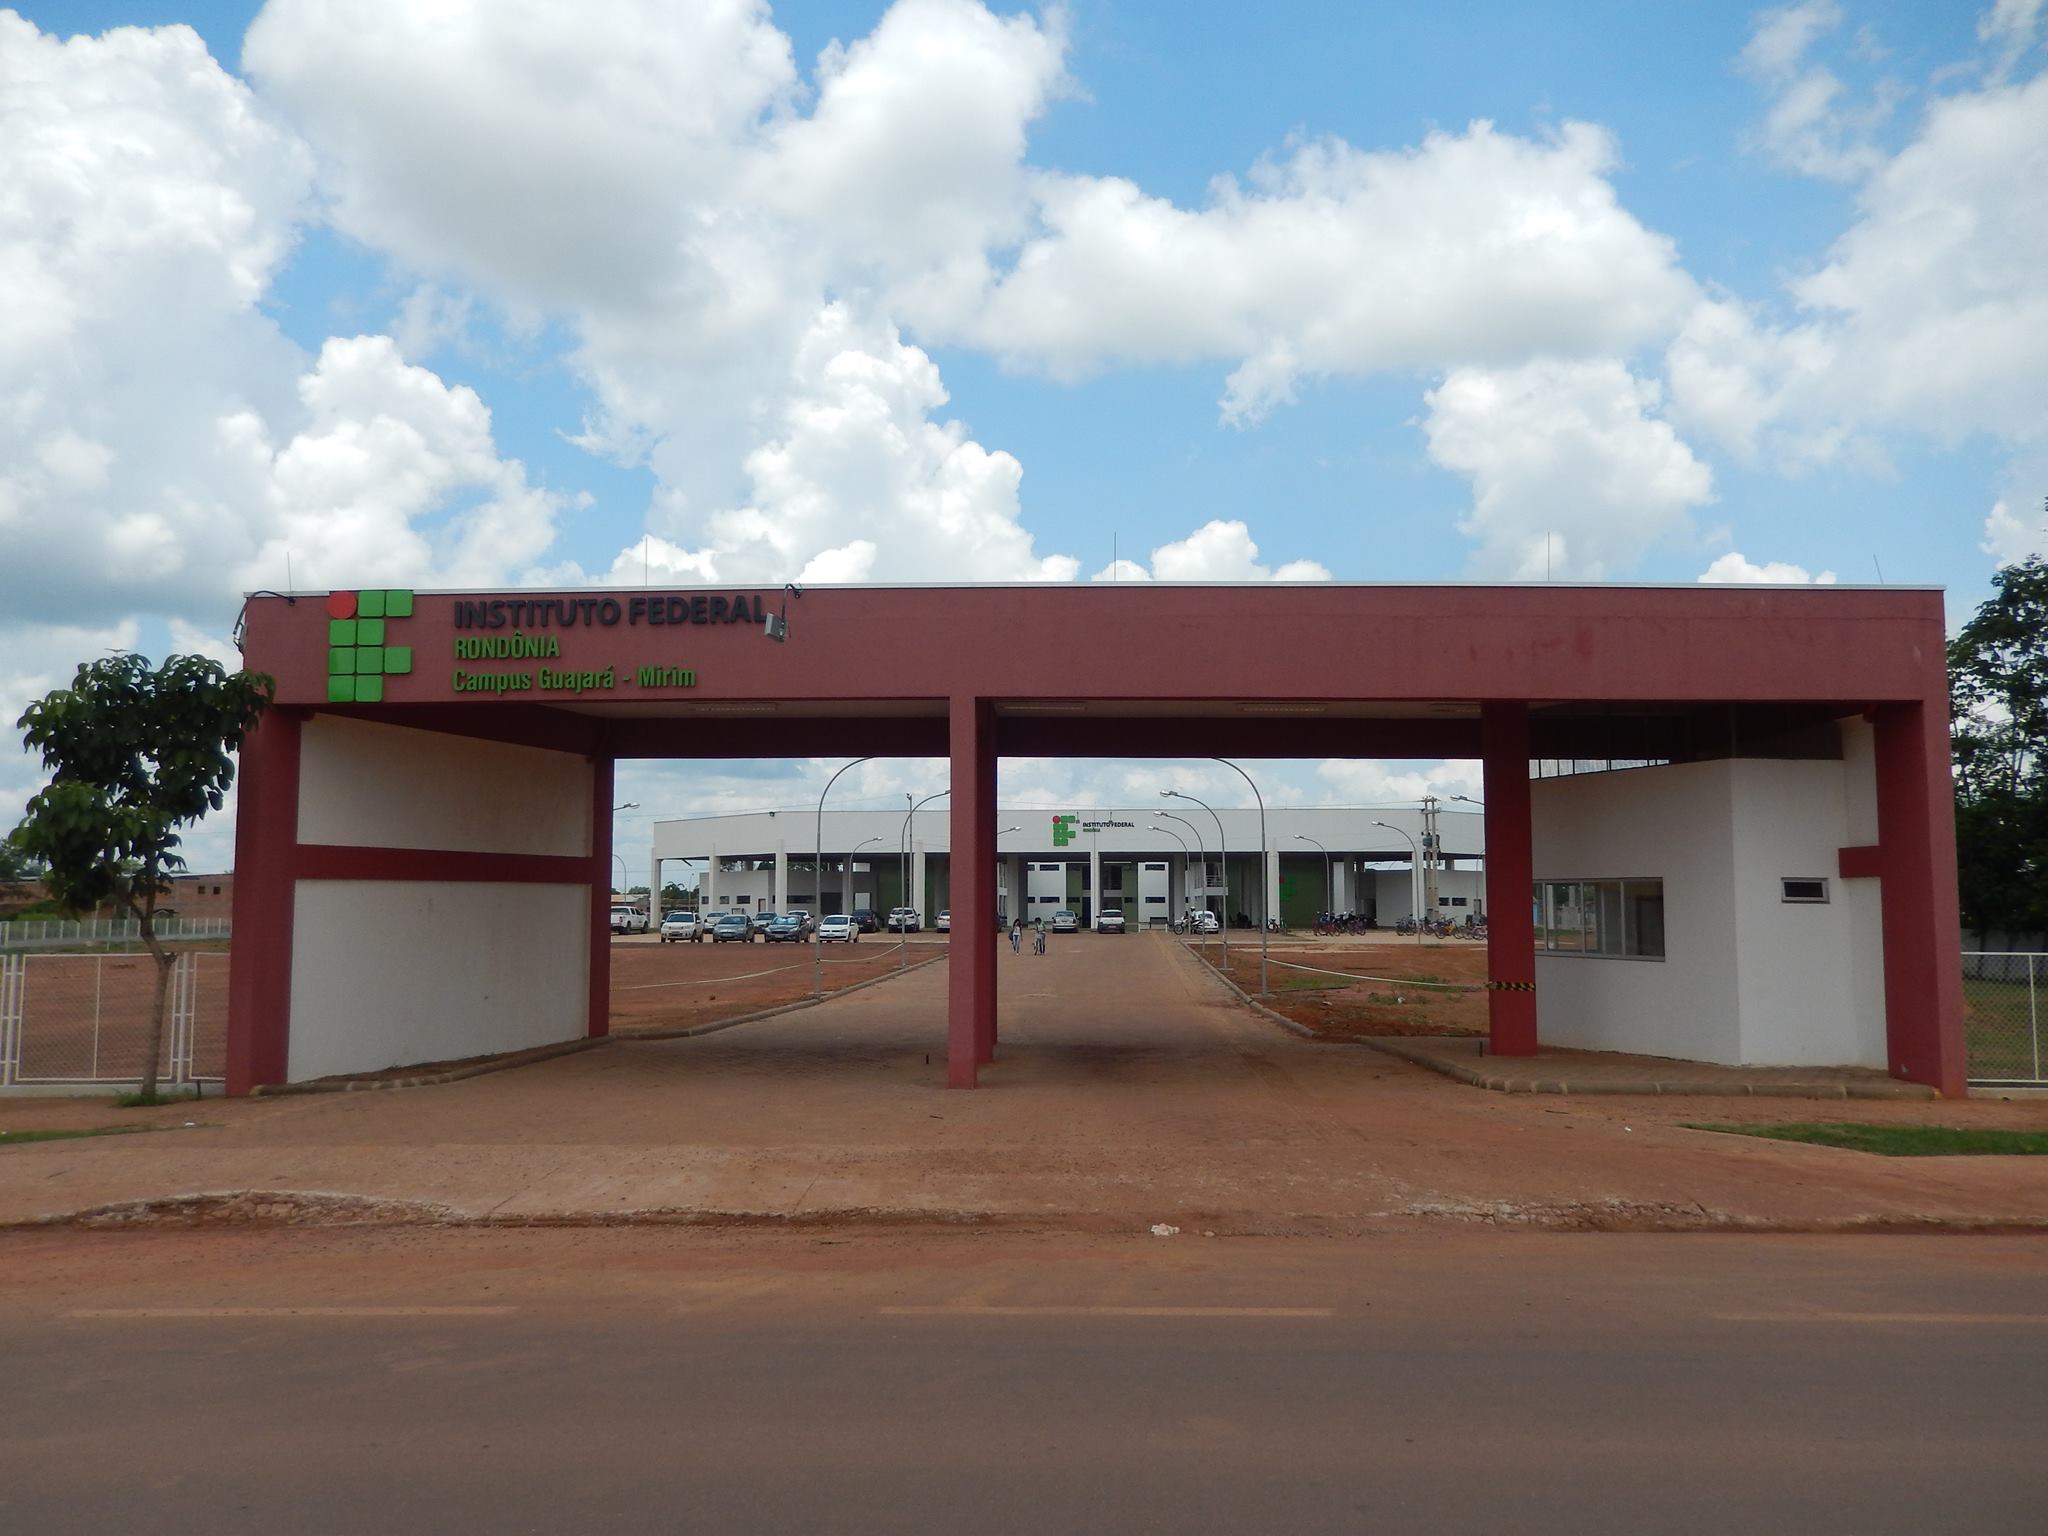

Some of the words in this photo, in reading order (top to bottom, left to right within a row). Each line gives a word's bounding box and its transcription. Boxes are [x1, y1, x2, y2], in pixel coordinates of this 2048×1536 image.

[454, 598, 621, 628] INSTITUTO
[629, 595, 767, 625] FEDERAL
[455, 629, 560, 659] RONDÔNIA
[453, 668, 532, 695] Campus
[538, 665, 614, 694] Guajará
[637, 665, 696, 688] Mirim
